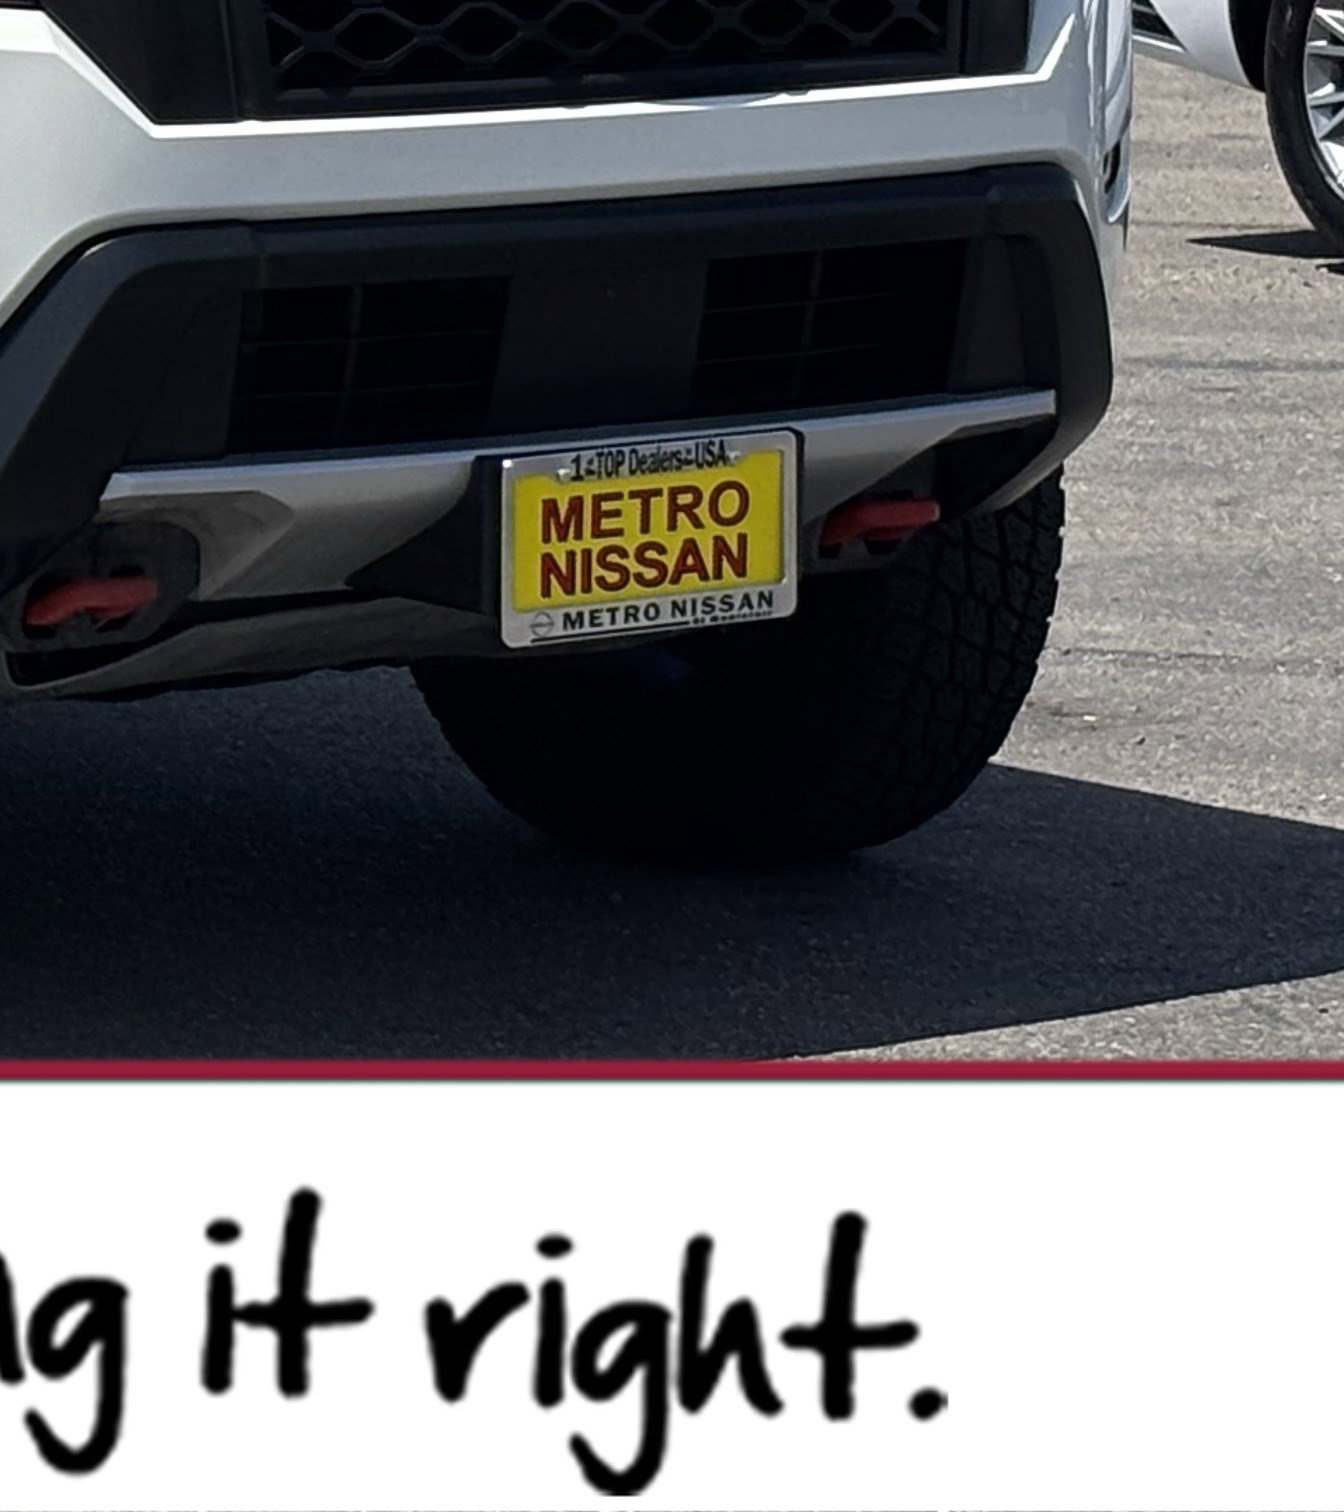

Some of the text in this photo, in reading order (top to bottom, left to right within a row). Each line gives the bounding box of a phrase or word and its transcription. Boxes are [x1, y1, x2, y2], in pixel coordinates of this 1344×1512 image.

[595, 449, 627, 481] TOP
[628, 445, 685, 477] Dealers
[540, 480, 751, 544] METRO
[539, 532, 749, 600] NISSAN
[562, 601, 661, 631] METRO
[670, 590, 775, 619] NISSAN
